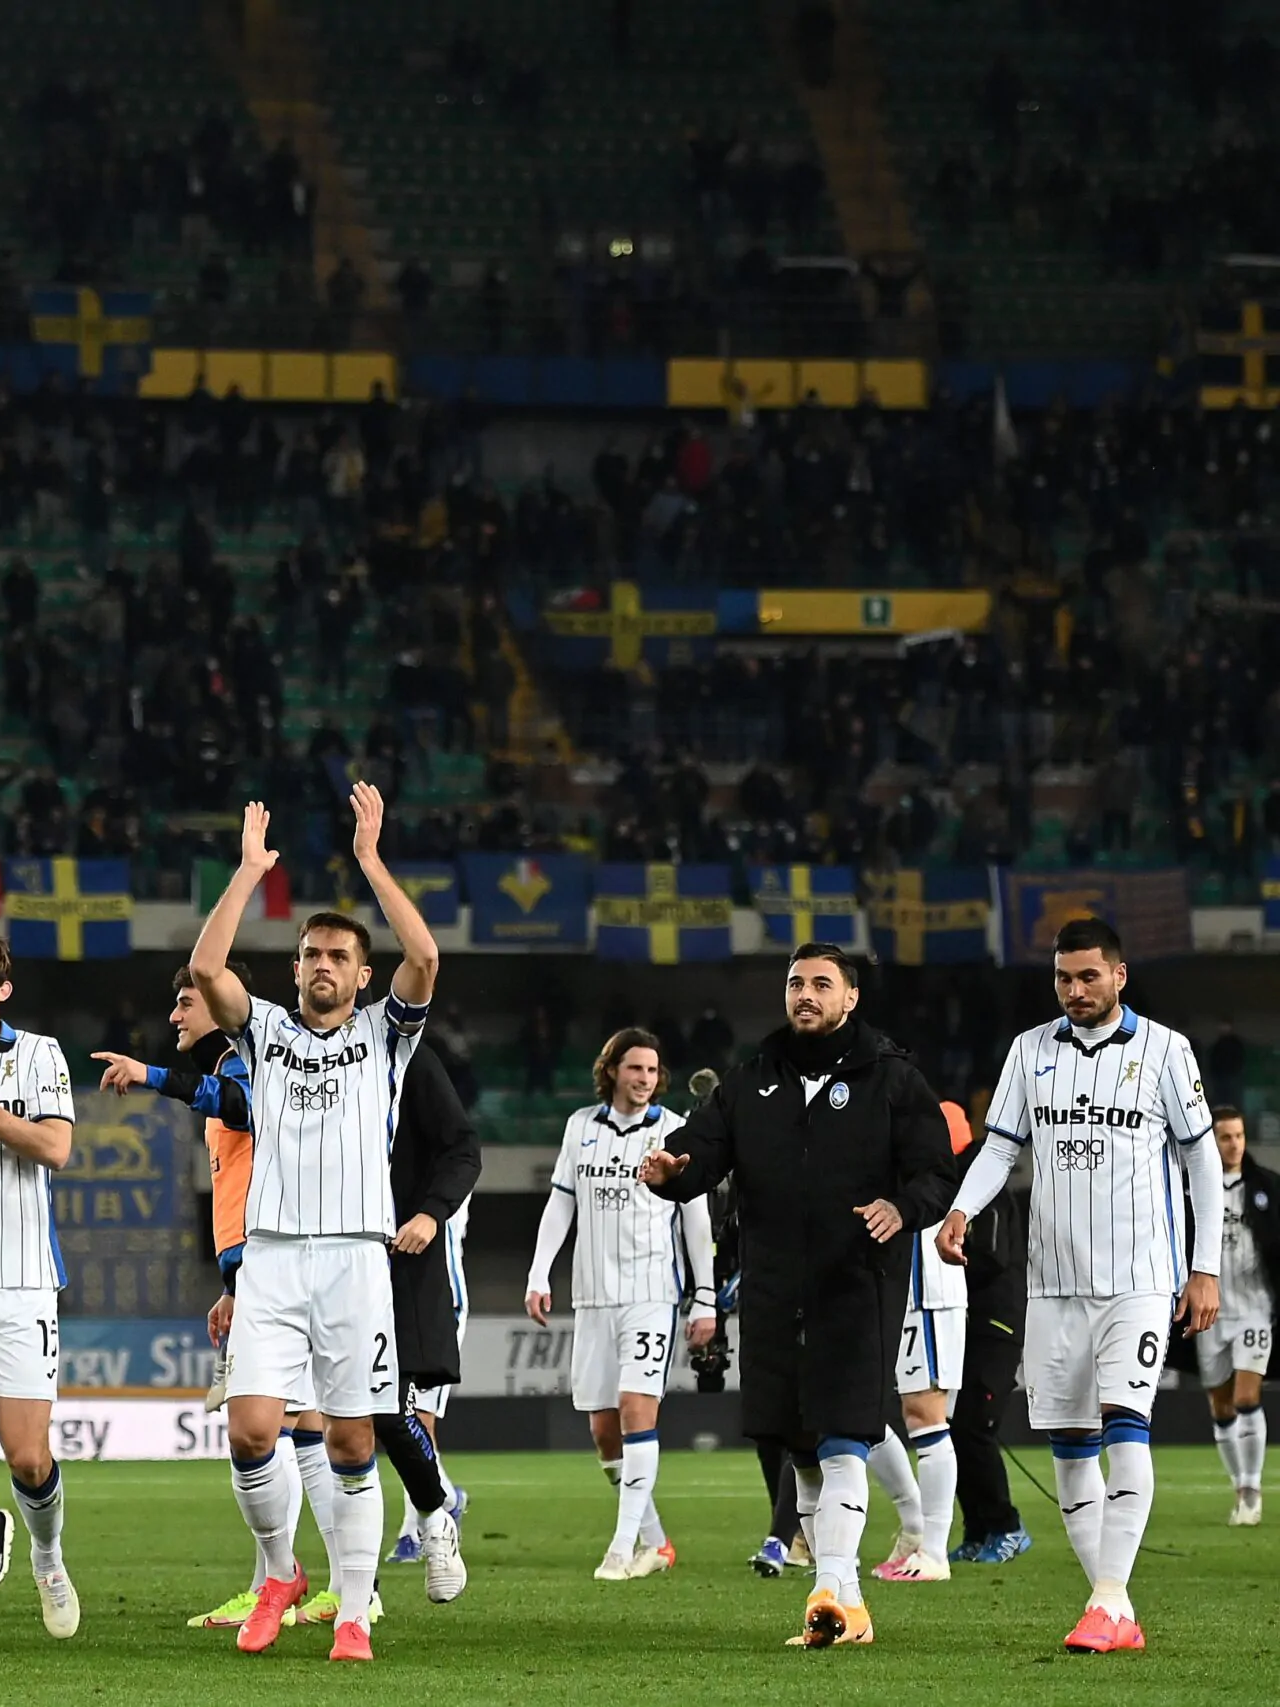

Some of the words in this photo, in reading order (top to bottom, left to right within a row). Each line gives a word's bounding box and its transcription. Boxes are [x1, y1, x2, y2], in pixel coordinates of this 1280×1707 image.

[264, 1042, 368, 1074] Plus500
[290, 1094, 339, 1111] GROUP
[1034, 1105, 1144, 1129] Plus500
[1056, 1139, 1104, 1157] RADICI
[577, 1164, 638, 1180] Plus5
[1056, 1155, 1104, 1171] GROUP
[634, 1331, 667, 1362] 33
[903, 1325, 918, 1357] 7
[1137, 1331, 1158, 1368] 6
[1243, 1328, 1269, 1350] 88
[372, 1332, 388, 1373] 2
